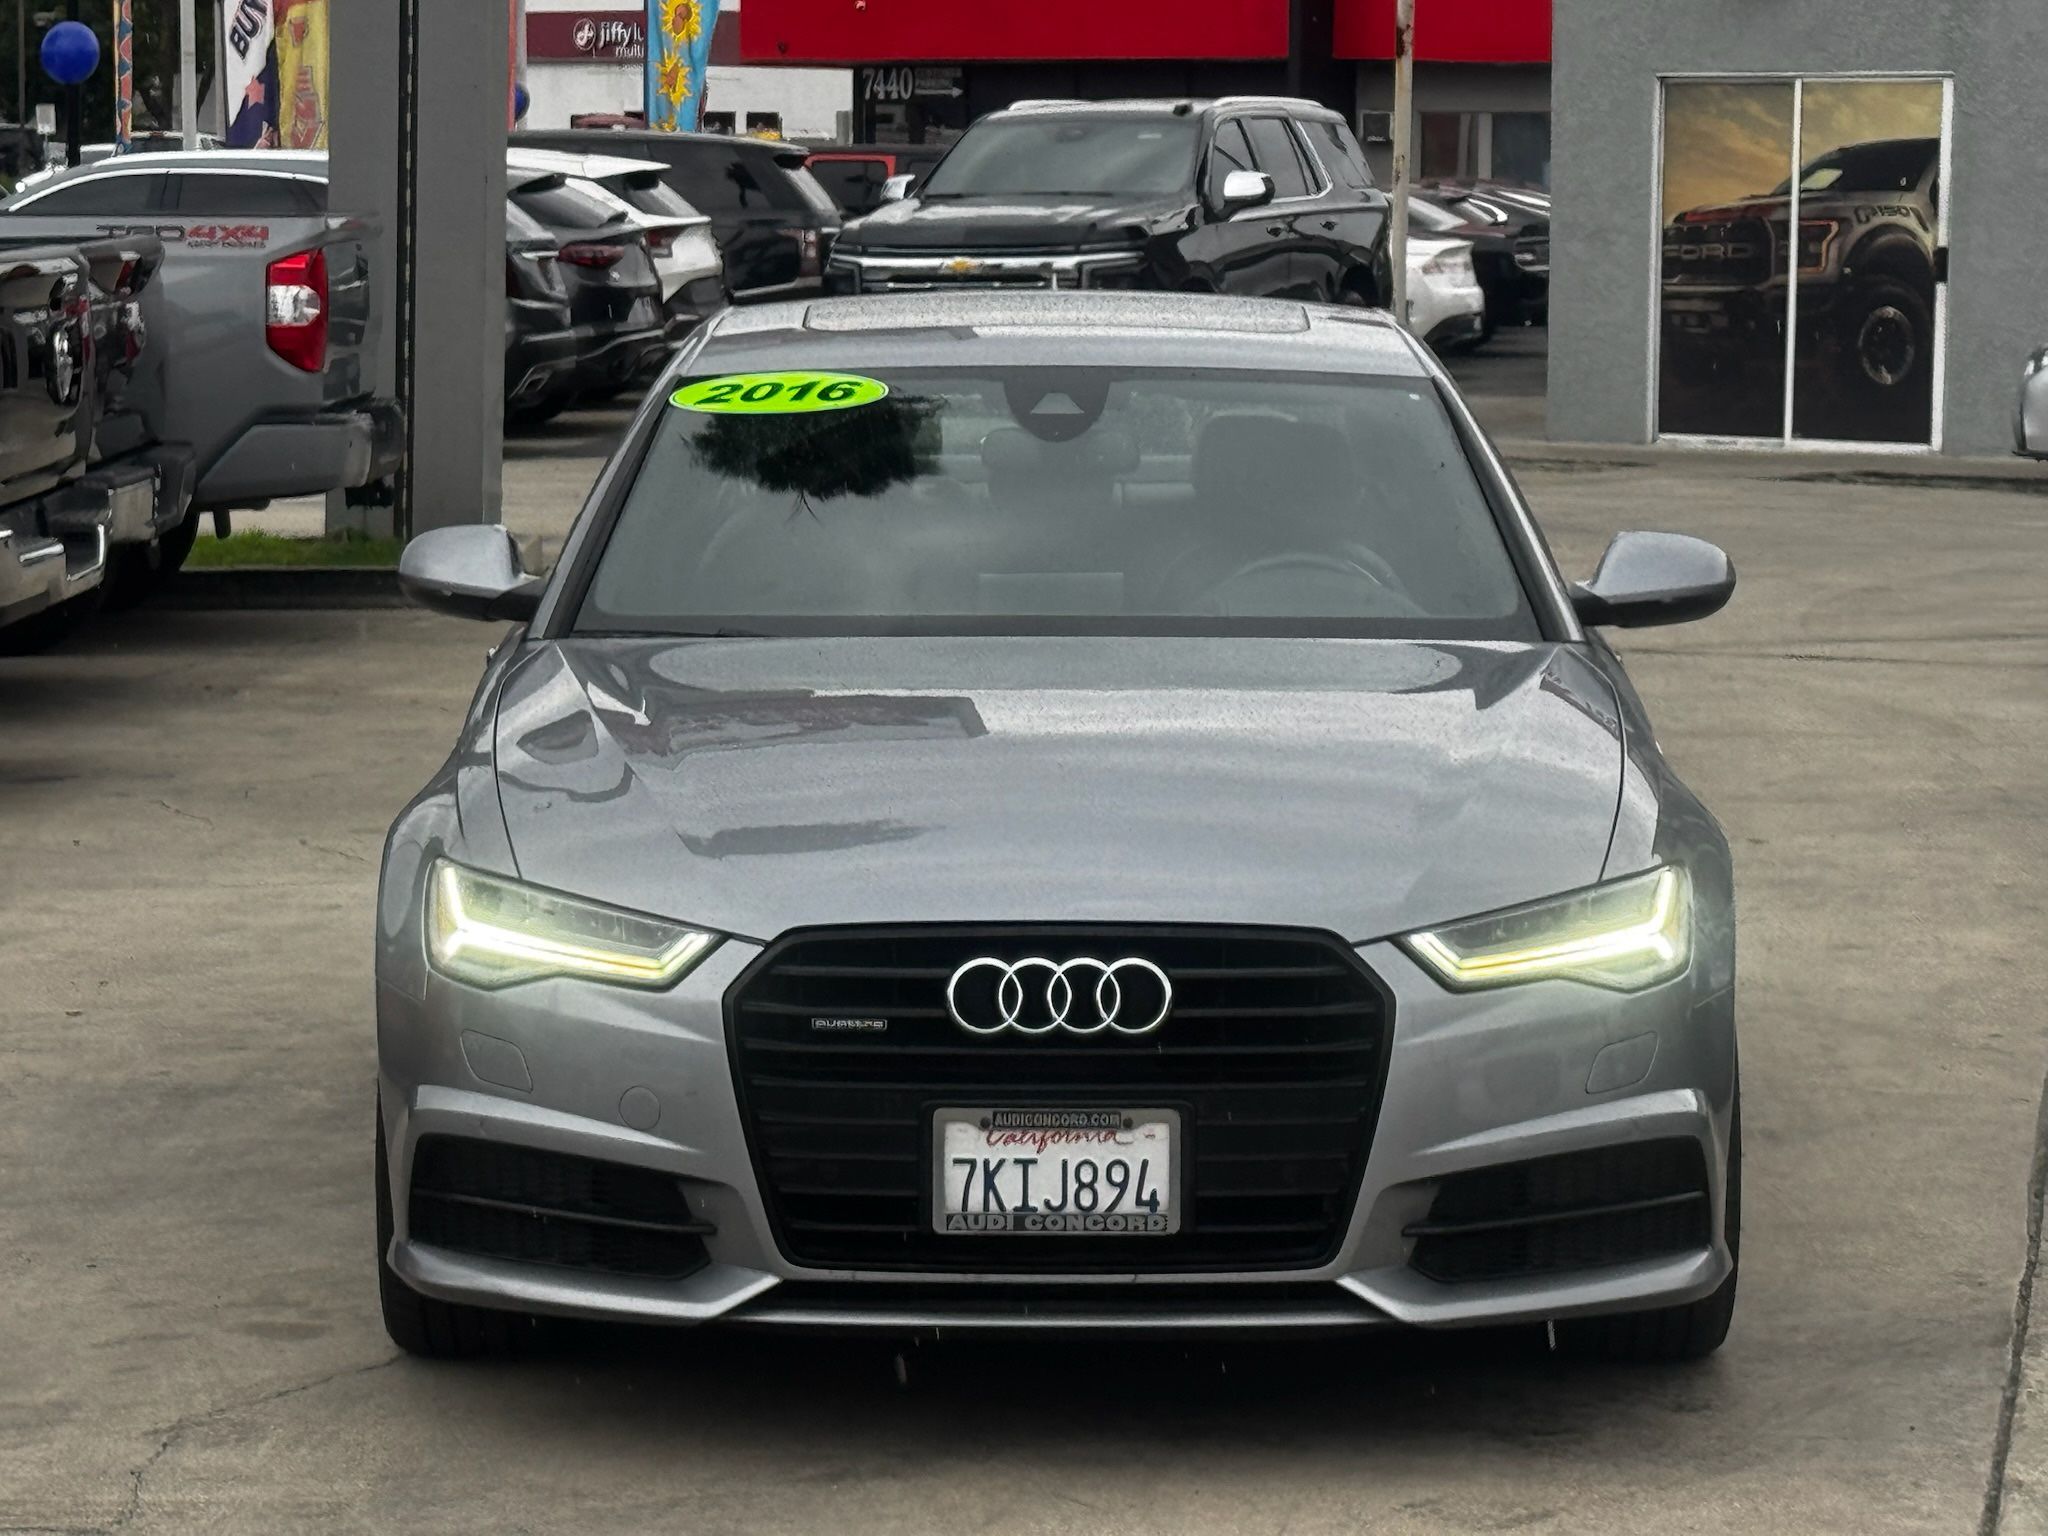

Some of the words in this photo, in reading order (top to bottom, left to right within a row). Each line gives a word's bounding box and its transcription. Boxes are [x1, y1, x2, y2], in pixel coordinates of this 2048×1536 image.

[599, 21, 632, 49] jiffy
[862, 67, 913, 100] 7440
[693, 380, 864, 406] 2016
[952, 1157, 1161, 1213] 7KIJ894
[946, 1213, 1014, 1231] AUDI
[1024, 1213, 1168, 1231] CONCORD
